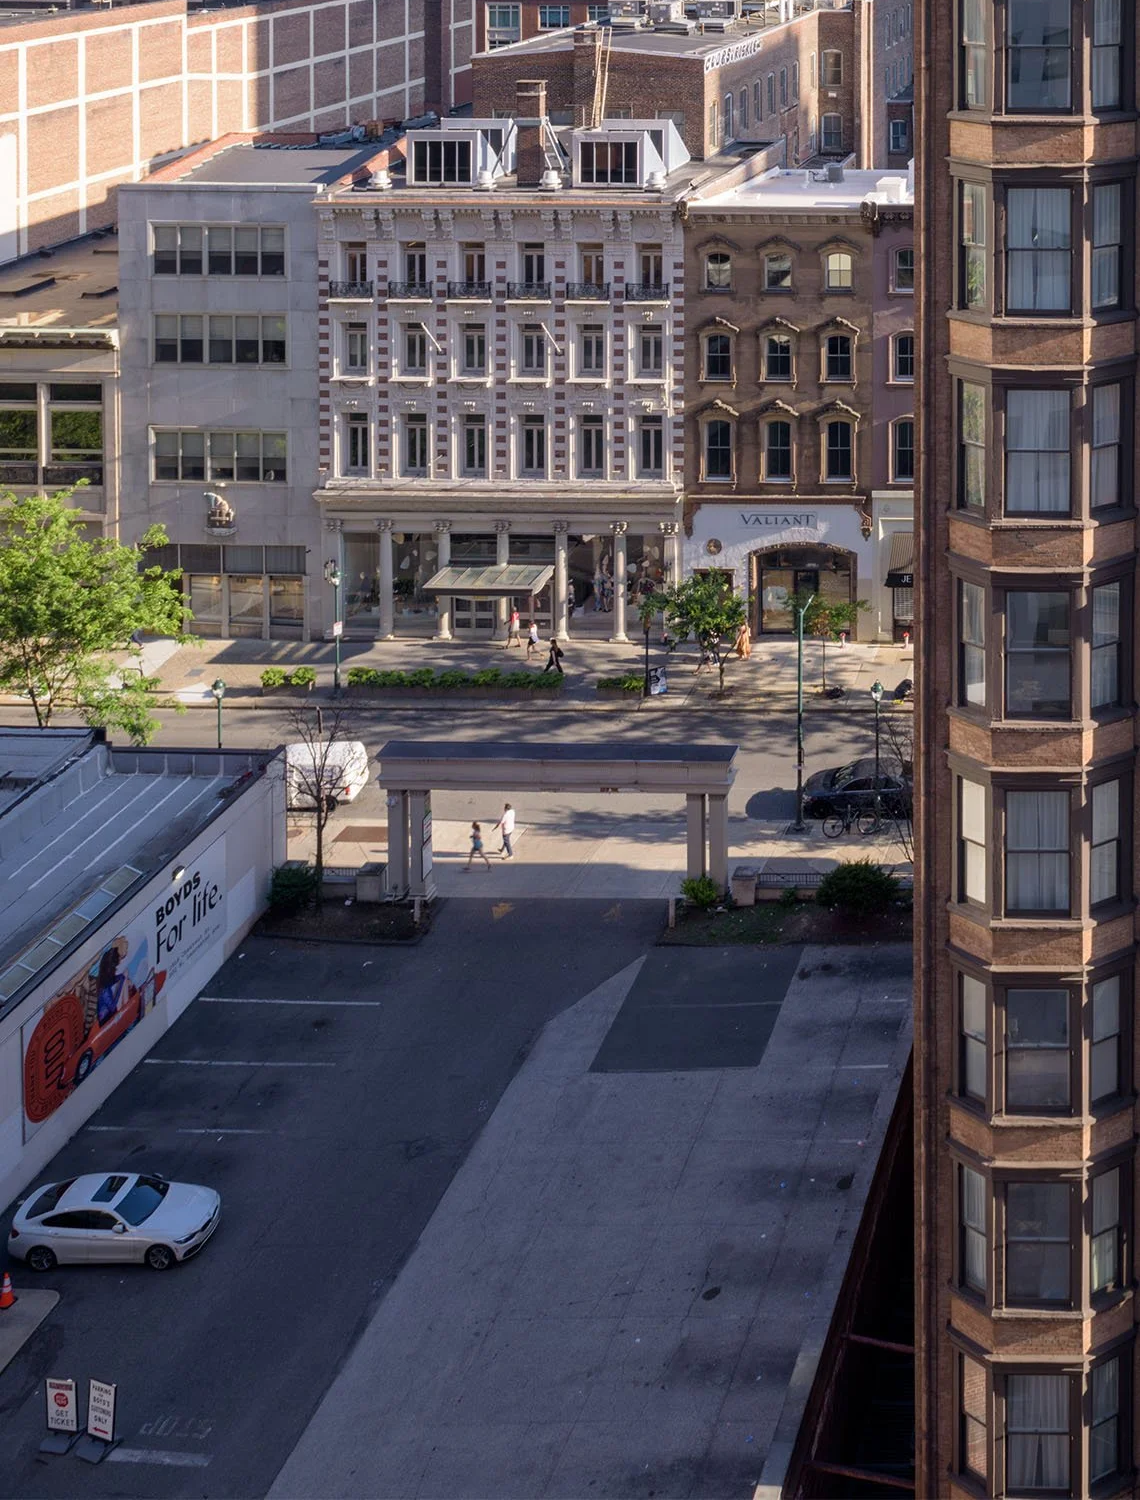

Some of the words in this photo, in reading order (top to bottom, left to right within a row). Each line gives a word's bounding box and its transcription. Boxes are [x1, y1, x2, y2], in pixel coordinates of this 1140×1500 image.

[740, 513, 815, 526] VALIANT
[156, 871, 200, 927] BOYDS
[156, 915, 187, 964] For
[192, 881, 223, 927] life.
[92, 1383, 112, 1396] PARKING
[55, 1409, 69, 1417] GET
[94, 1414, 108, 1425] ONLY
[50, 1417, 74, 1426] TICKET
